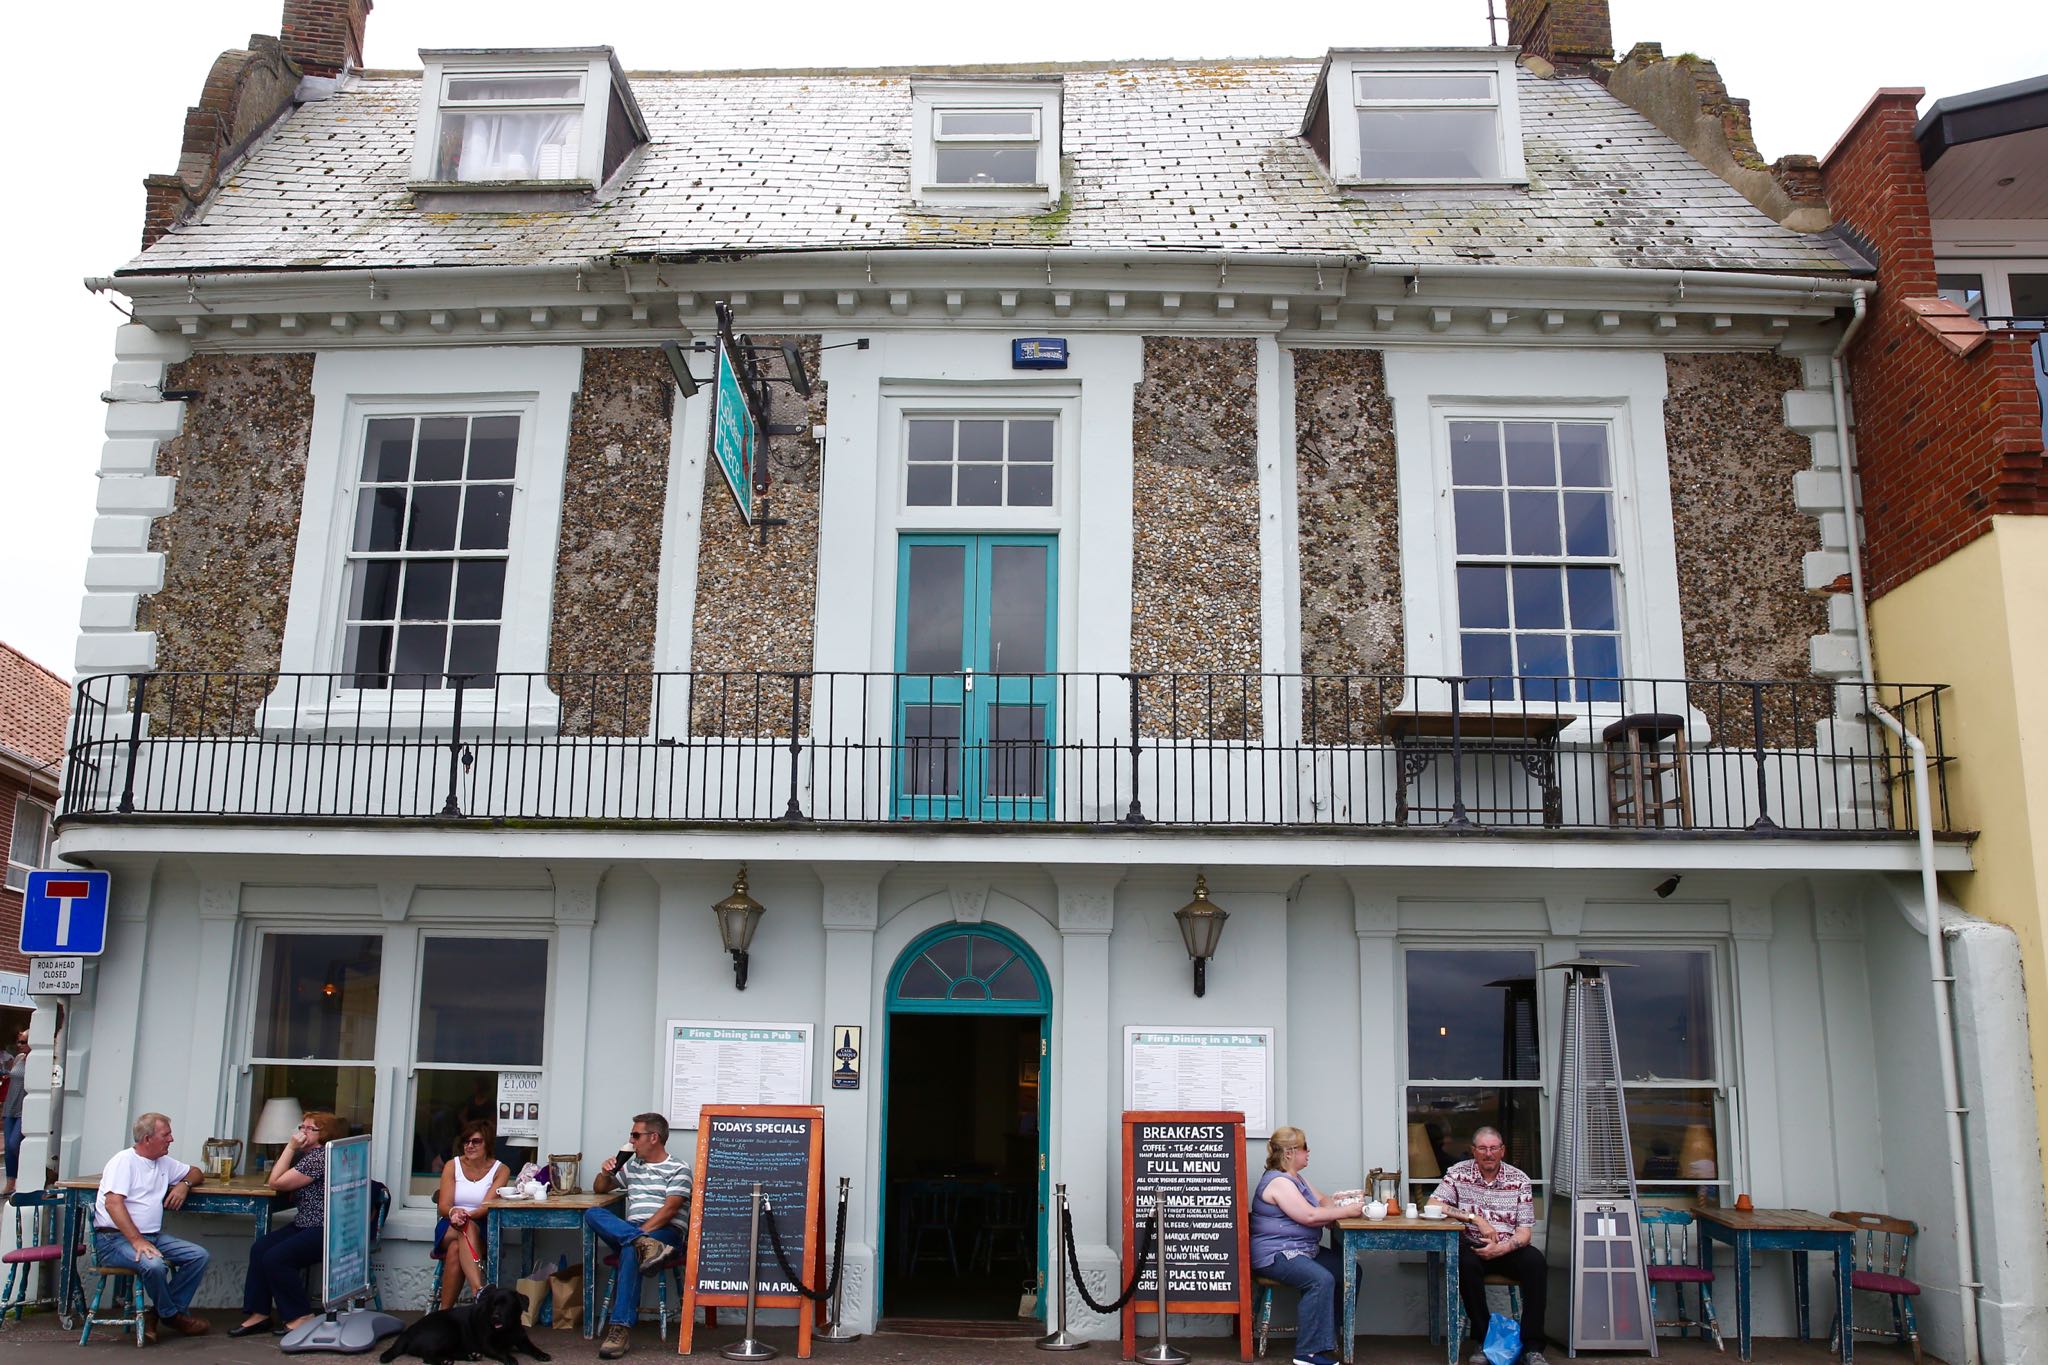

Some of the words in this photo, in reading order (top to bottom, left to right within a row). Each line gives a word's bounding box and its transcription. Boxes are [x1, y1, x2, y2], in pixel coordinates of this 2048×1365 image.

[721, 389, 742, 452] Golden
[719, 415, 740, 484] Fleece
[0, 978, 26, 1003] mply
[714, 1030, 748, 1040] Dining
[1172, 1035, 1207, 1045] Dining
[504, 1080, 537, 1090] £1,000
[713, 1122, 752, 1132] TODAYS
[755, 1123, 805, 1134] SPECIALS
[1143, 1126, 1224, 1139] BREAKFASTS
[1147, 1161, 1179, 1172] FULL
[1183, 1161, 1221, 1172] MENU
[1136, 1196, 1158, 1206] HAN
[1167, 1196, 1195, 1206] MADE
[1197, 1196, 1232, 1206] PIZZAS
[1169, 1270, 1196, 1280] PLACE
[1197, 1271, 1208, 1280] TO
[1209, 1271, 1225, 1280] EAT
[699, 1280, 720, 1290] FINE
[721, 1281, 749, 1291] DININ
[759, 1282, 770, 1291] IN
[772, 1282, 780, 1291] A
[1168, 1282, 1196, 1290] PLACE
[1197, 1282, 1208, 1290] TO
[1209, 1282, 1231, 1291] MEET
